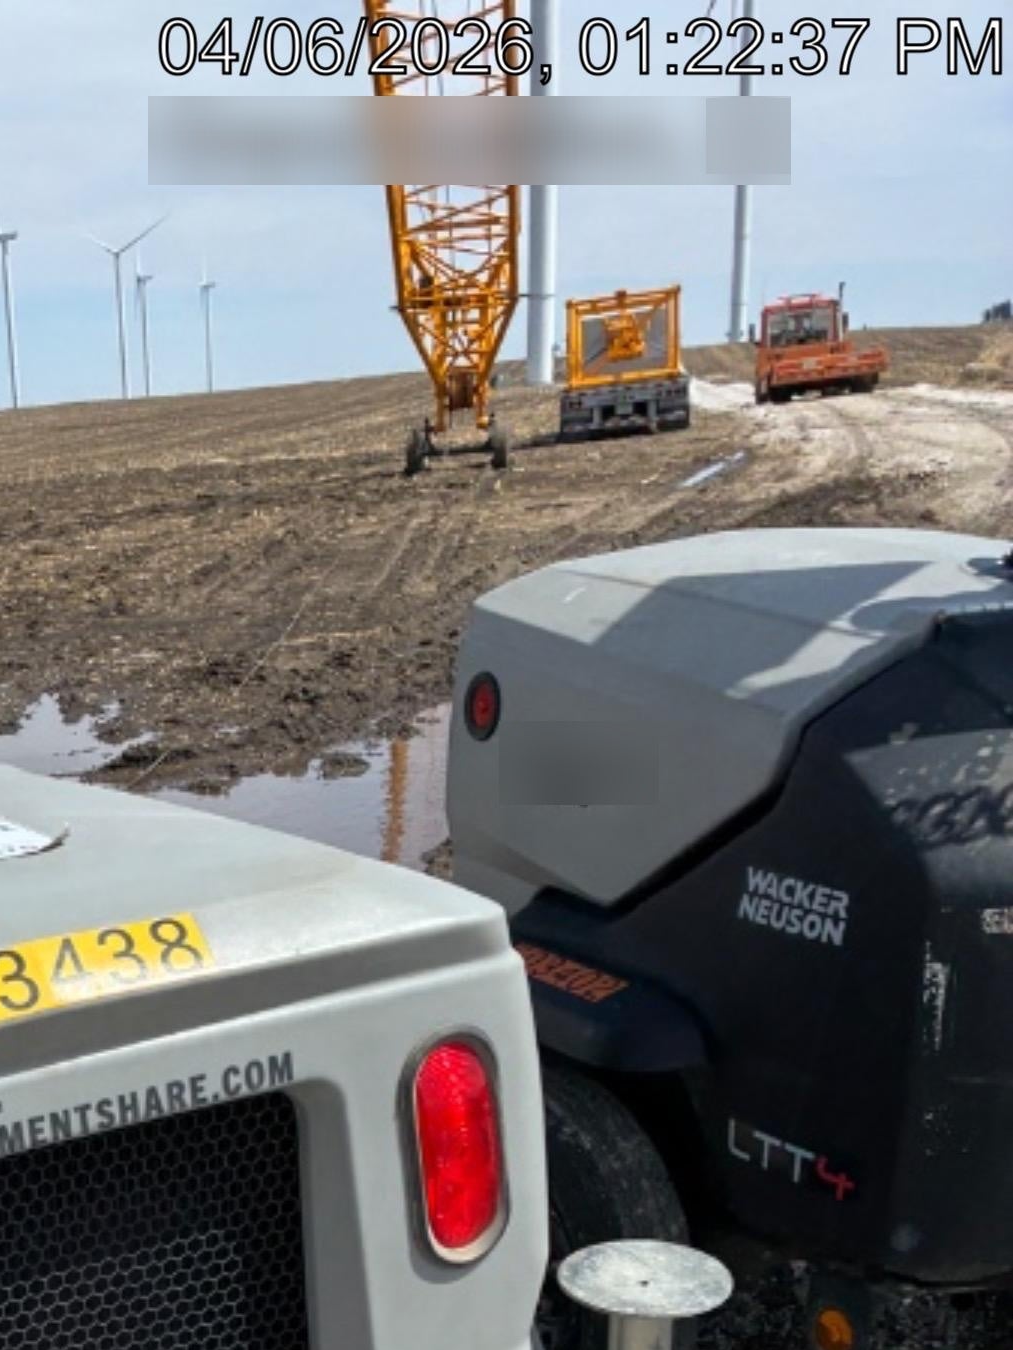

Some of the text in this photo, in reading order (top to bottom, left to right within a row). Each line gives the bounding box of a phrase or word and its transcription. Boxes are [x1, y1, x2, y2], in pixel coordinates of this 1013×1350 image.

[746, 865, 850, 919] WACKER
[738, 893, 846, 946] NEUSON
[728, 1118, 855, 1201] LTT4
